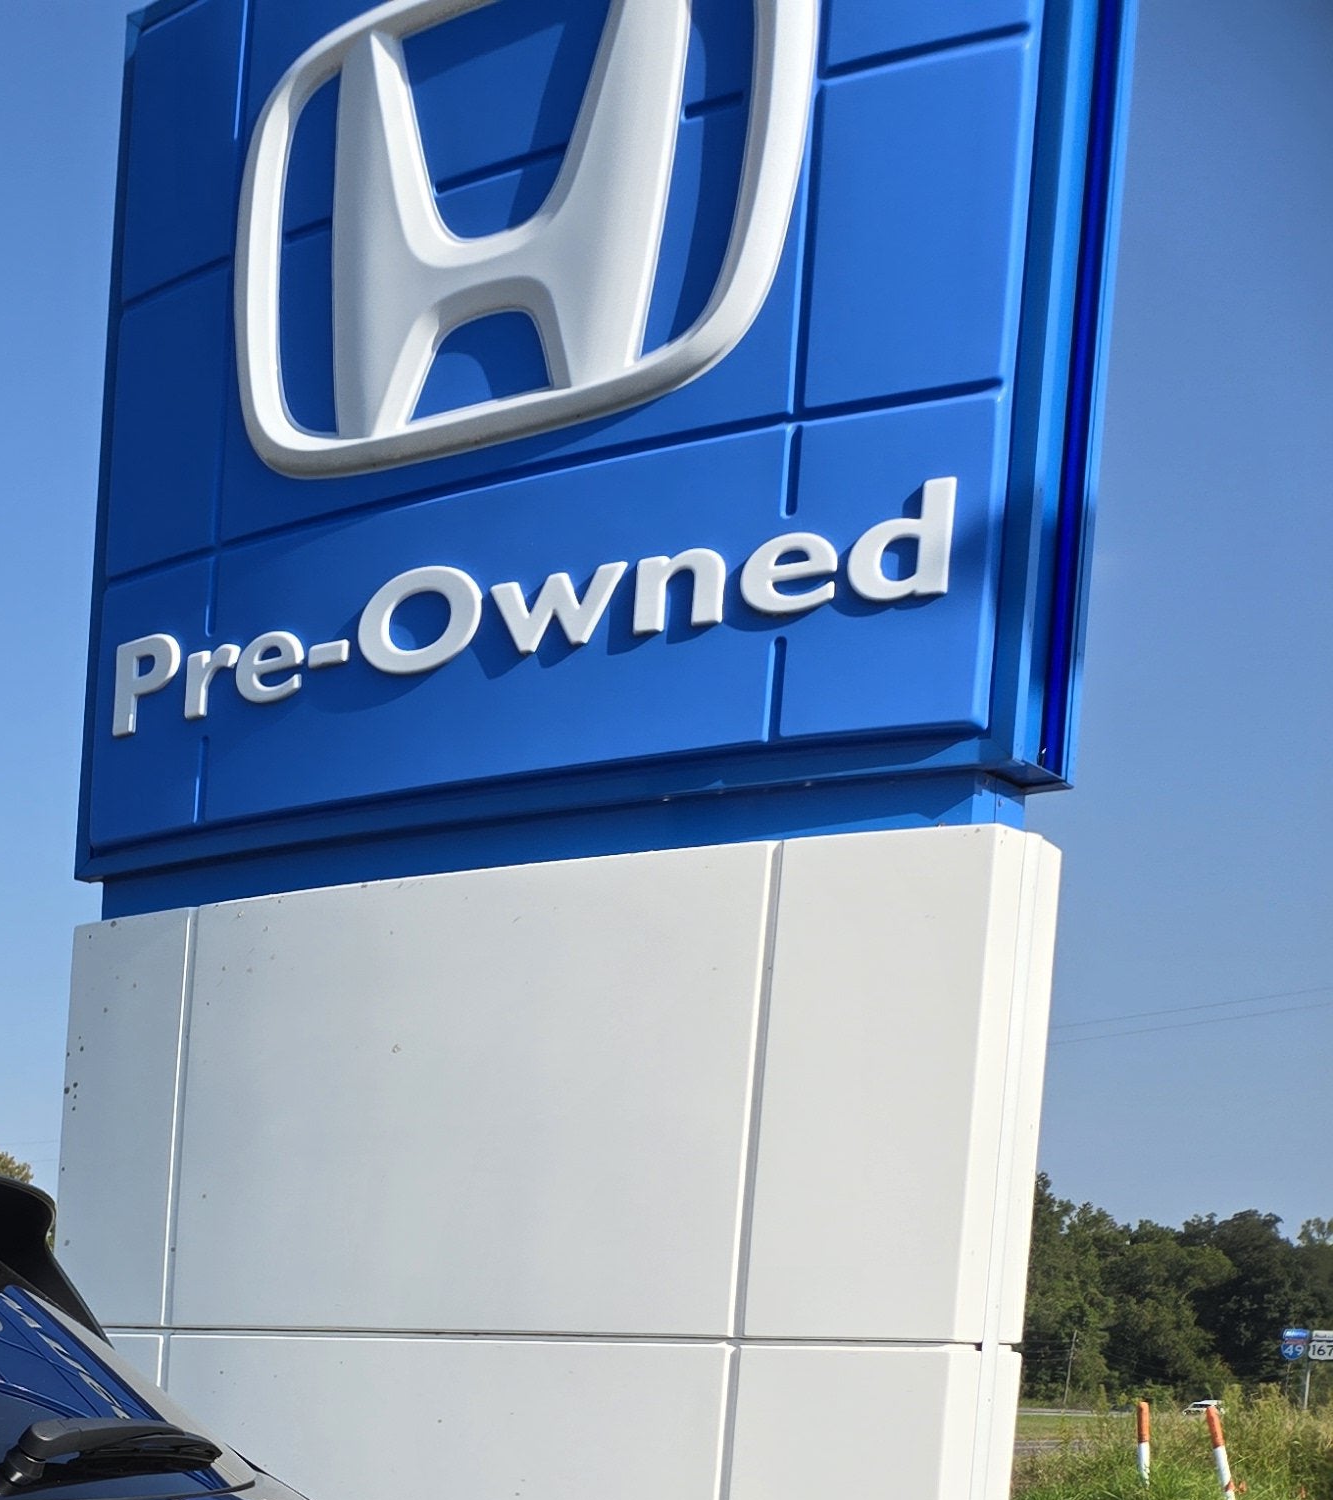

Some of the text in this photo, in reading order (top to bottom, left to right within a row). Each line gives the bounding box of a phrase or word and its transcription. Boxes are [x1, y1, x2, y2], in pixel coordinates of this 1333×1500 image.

[112, 476, 958, 738] Pre-Owned
[1284, 1344, 1304, 1356] 49
[1312, 1344, 1333, 1357] 167
